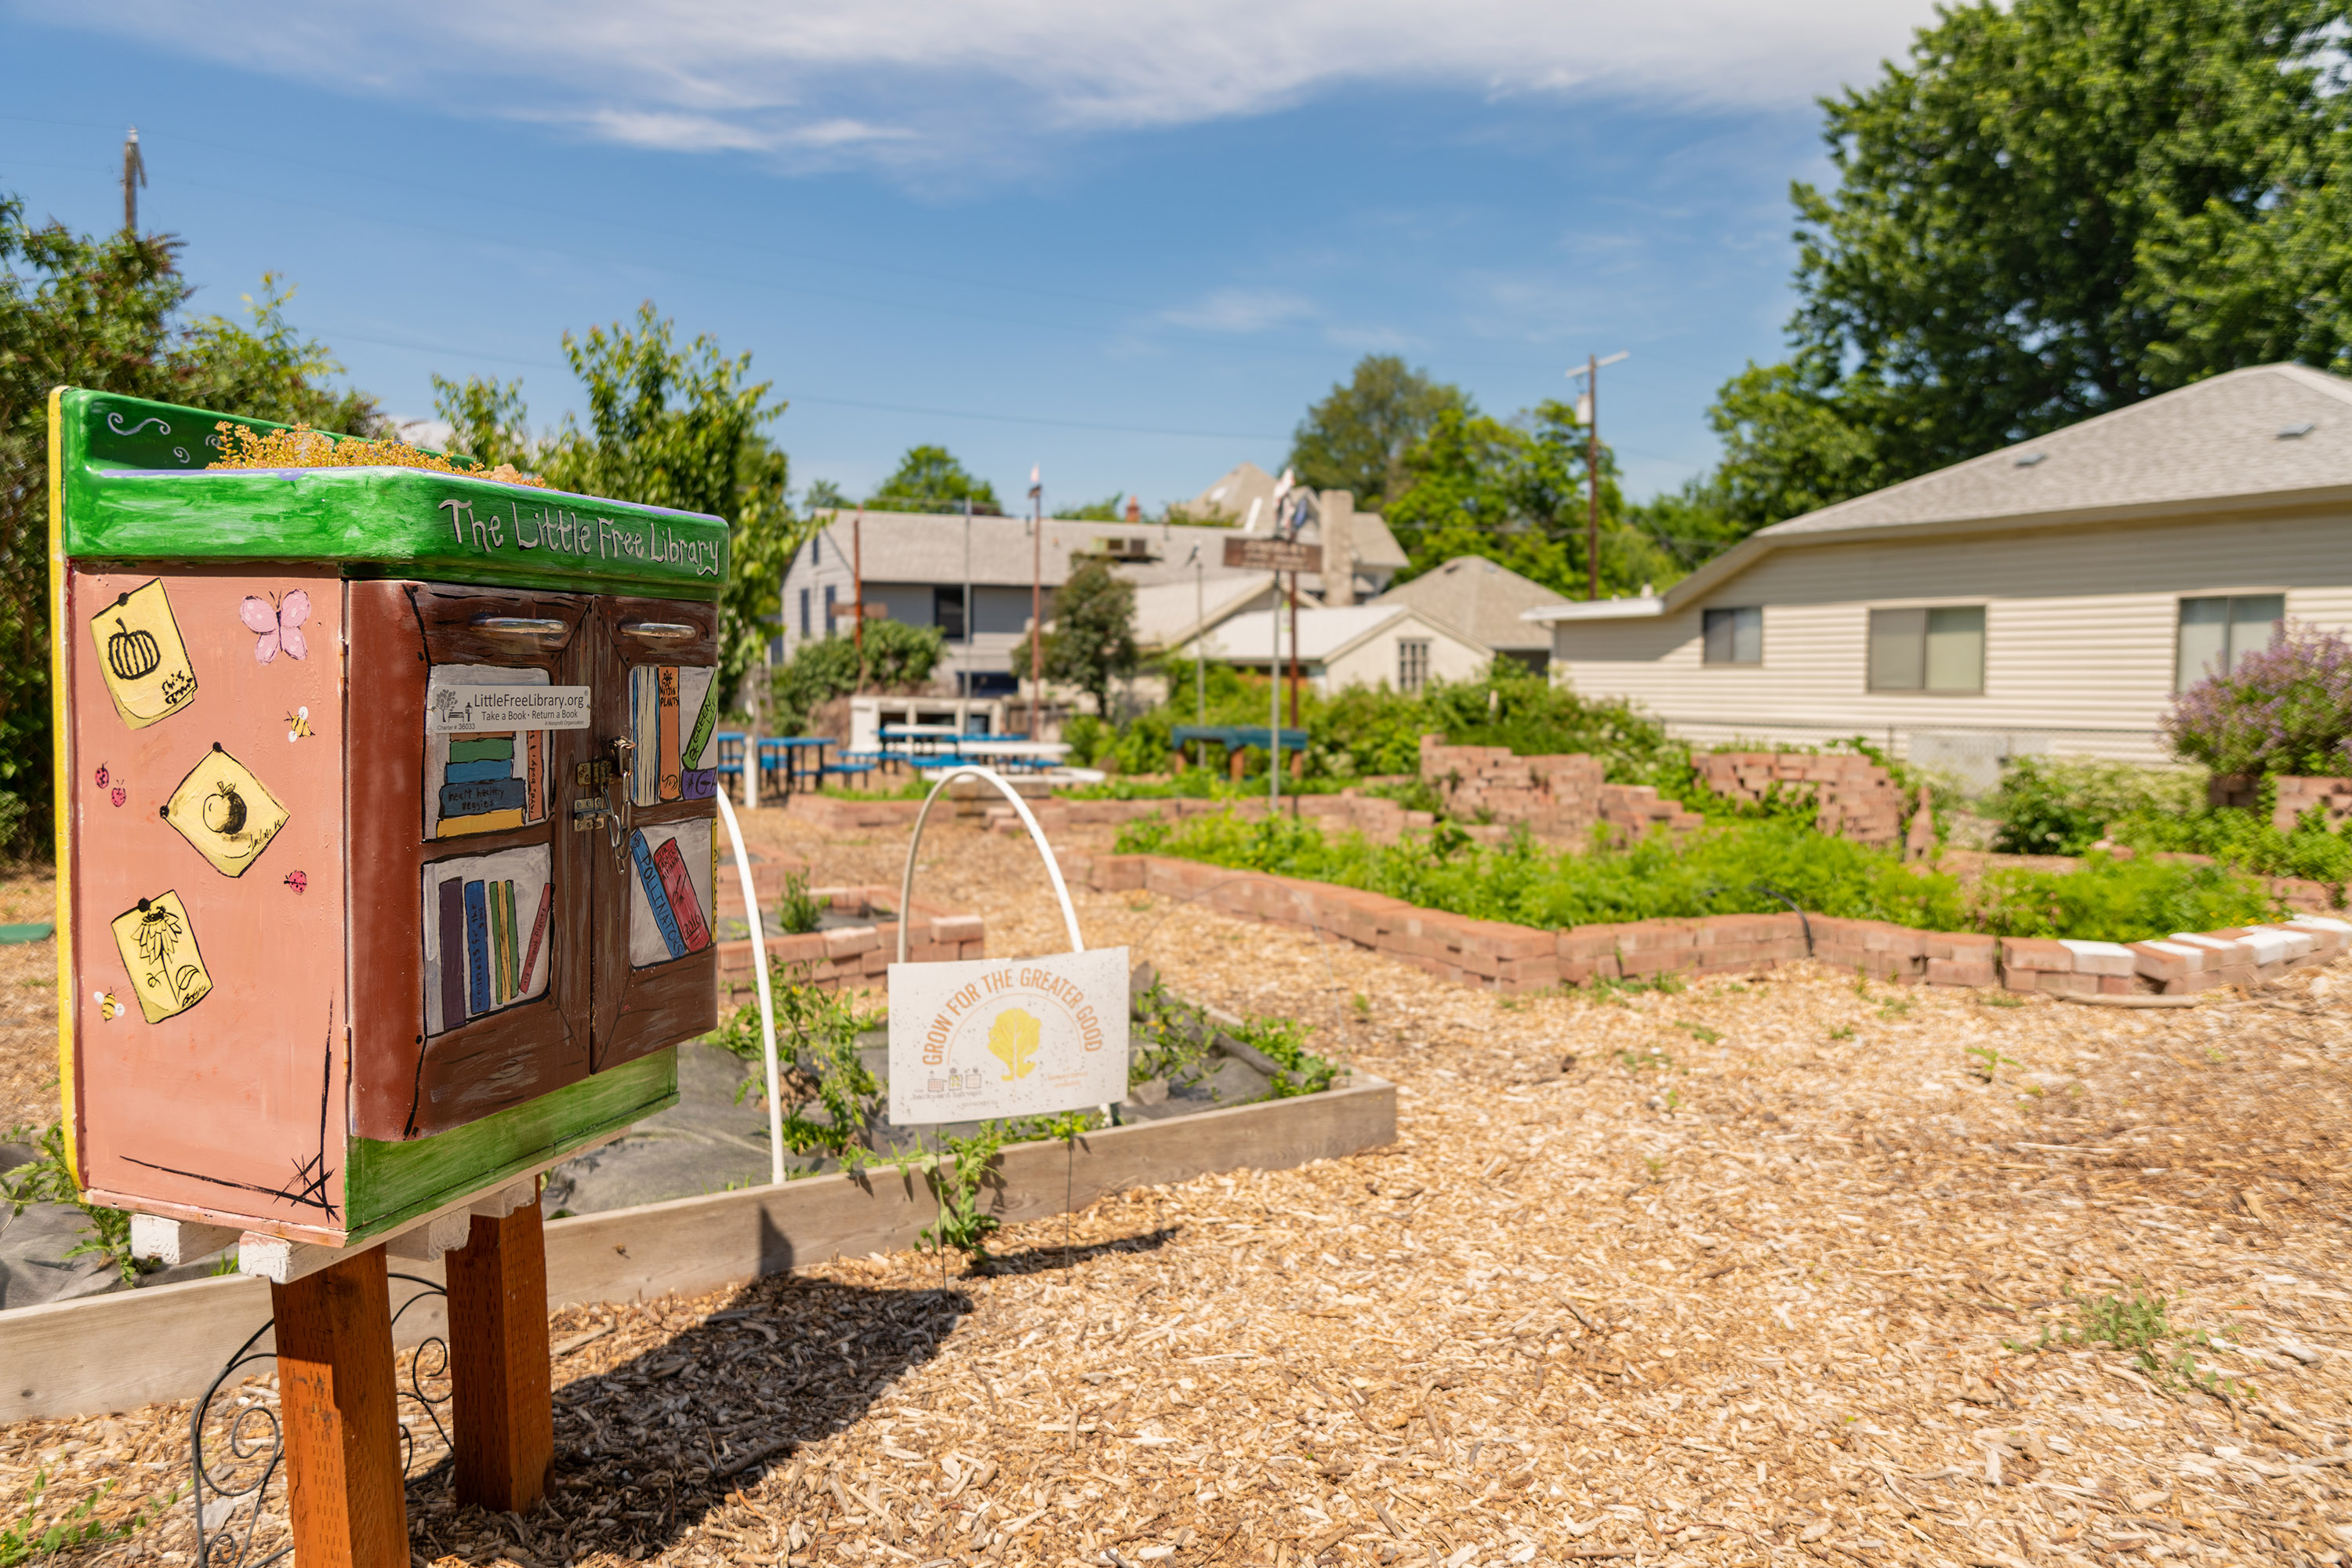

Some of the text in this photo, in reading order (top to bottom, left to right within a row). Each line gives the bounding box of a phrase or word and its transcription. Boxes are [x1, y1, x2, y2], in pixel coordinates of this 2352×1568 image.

[438, 498, 720, 577] The Little Free Library
[474, 693, 584, 709] LittleFreeLibrary.org
[482, 710, 500, 721] Take
[532, 710, 555, 720] Return
[562, 709, 578, 719] Book
[693, 698, 711, 743] GREEN
[448, 786, 505, 802] heart healthy
[462, 799, 494, 811] veggies
[641, 849, 684, 956] POLLINATORS
[683, 911, 702, 939] 2016
[922, 967, 1103, 1065] GROW FOR THE GREATER GOOD
